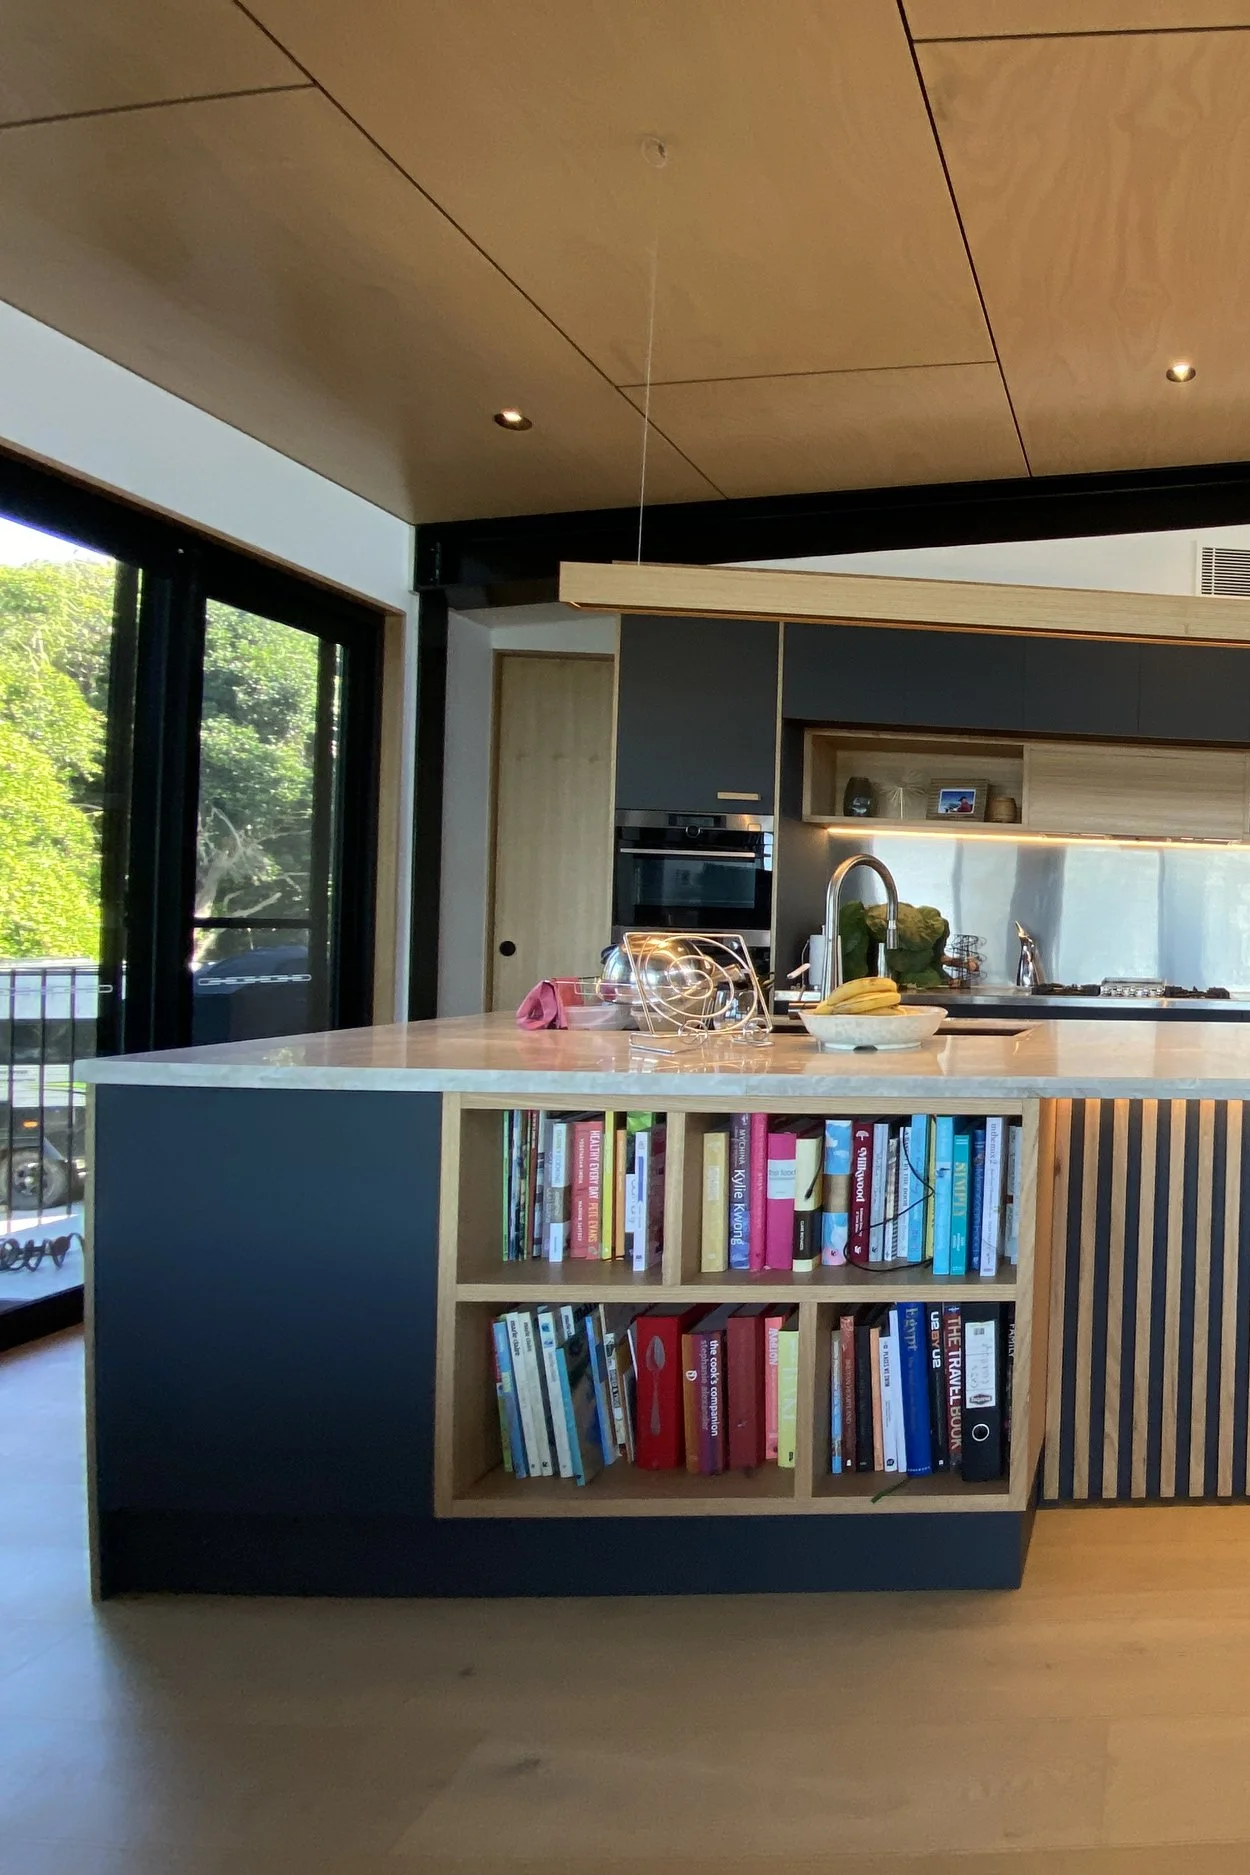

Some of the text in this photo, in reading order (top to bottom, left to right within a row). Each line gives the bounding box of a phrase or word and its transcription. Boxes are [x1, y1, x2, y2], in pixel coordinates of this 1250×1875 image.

[587, 1130, 600, 1242] HEALTHY EVERY DAY PETE EVANS
[730, 1129, 746, 1245] MY CHINA Kylie Kwong
[854, 1146, 868, 1203] Milkwood
[953, 1162, 968, 1217] SIMPLY
[509, 1320, 521, 1357] marie claire
[523, 1321, 534, 1352] marie claire
[768, 1327, 779, 1366] MARION
[903, 1307, 919, 1351] Egypt
[698, 1339, 710, 1430] stephanie alexander
[882, 1351, 890, 1368] PLACES
[948, 1317, 962, 1450] THE TRAVEL BOOK
[708, 1339, 720, 1437] the cook's companion
